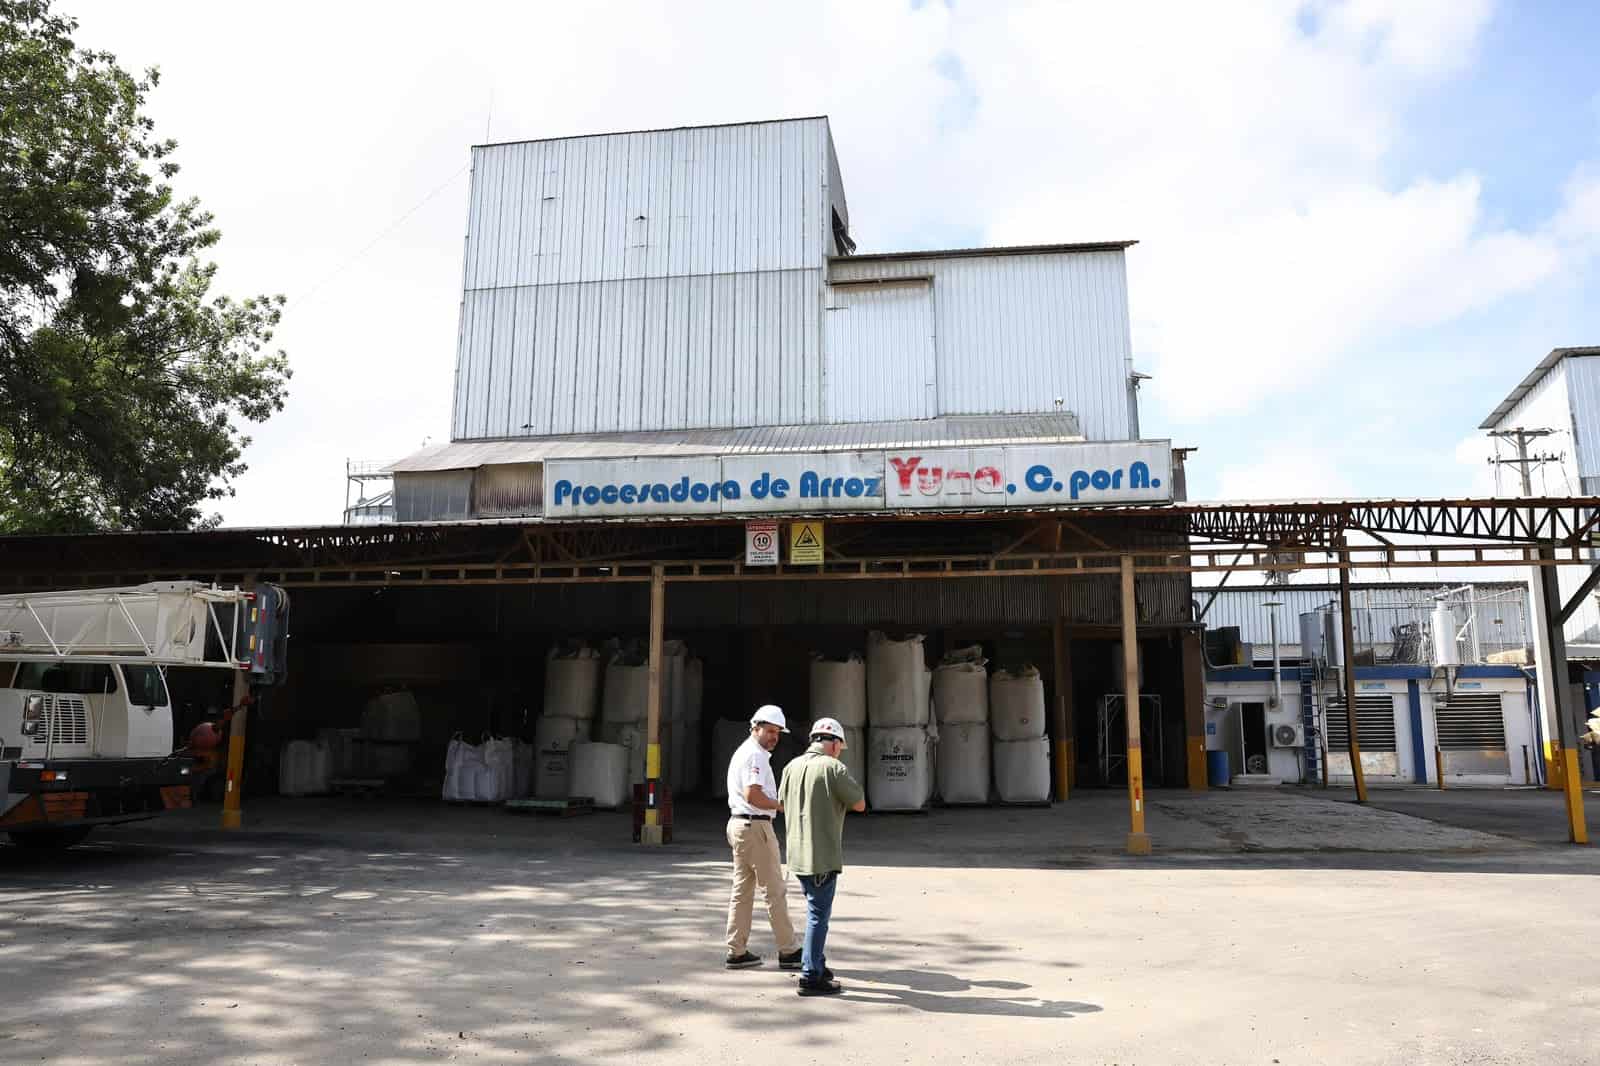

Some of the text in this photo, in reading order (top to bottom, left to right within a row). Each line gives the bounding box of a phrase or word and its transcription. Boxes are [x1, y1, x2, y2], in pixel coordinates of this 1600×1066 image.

[553, 476, 742, 505] Procesadora
[750, 471, 790, 500] de
[799, 469, 882, 498] Arroz
[1024, 463, 1064, 493] C.
[1069, 468, 1124, 500] por
[1129, 460, 1162, 489] A.
[757, 537, 768, 545] 10
